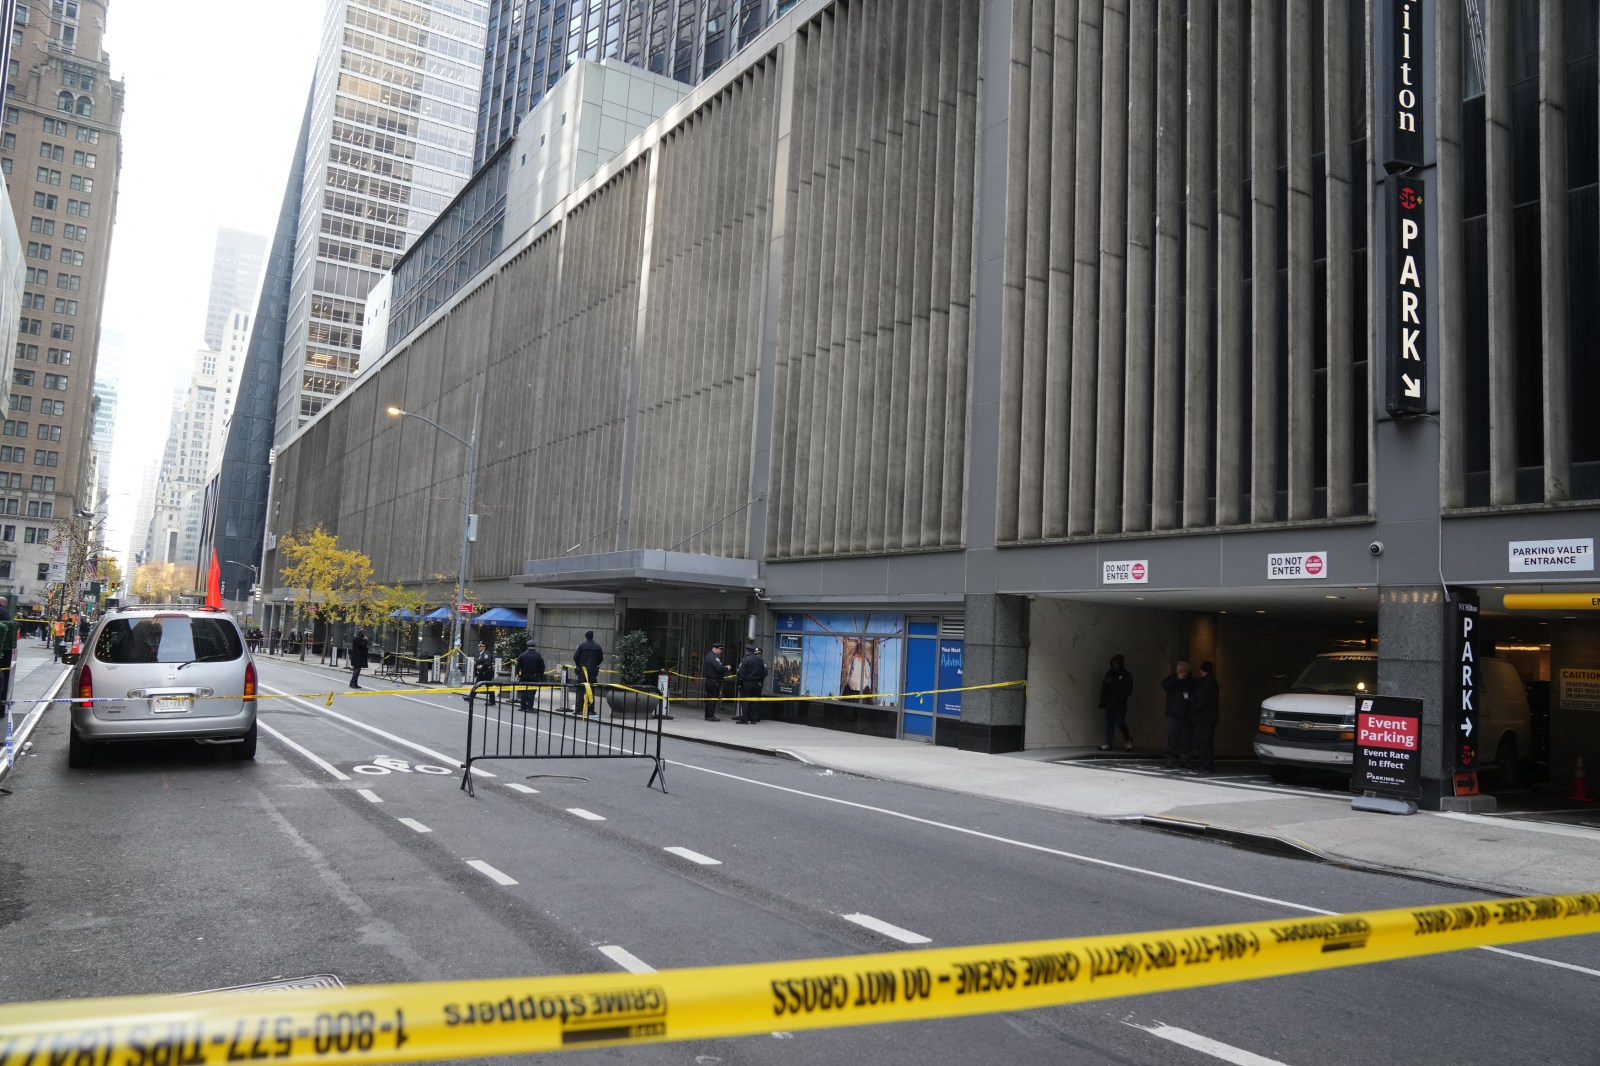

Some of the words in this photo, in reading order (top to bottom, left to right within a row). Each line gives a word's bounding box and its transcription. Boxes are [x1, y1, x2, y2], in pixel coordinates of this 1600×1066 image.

[1398, 0, 1416, 133] ilton
[1399, 218, 1421, 362] PARK
[1512, 546, 1555, 556] PARKING
[1557, 545, 1589, 554] VALET
[1105, 564, 1115, 572] DO
[1116, 564, 1130, 572] NOT
[1271, 557, 1283, 566] DO
[1284, 556, 1303, 566] NOT
[1524, 556, 1577, 566] ENTRANCE
[1106, 572, 1129, 580] ENTER
[1272, 566, 1301, 575] ENTER
[941, 653, 963, 669] Advent
[1461, 616, 1474, 711] PARK
[1367, 716, 1408, 731] Event
[1360, 729, 1414, 748] Parking
[1363, 748, 1388, 758] Event
[1389, 751, 1410, 760] Rate
[1368, 759, 1377, 767] In
[1378, 760, 1405, 770] Effect
[1019, 951, 1081, 988] CRIME
[901, 967, 933, 1002] DO
[953, 959, 1018, 997] SCENE
[770, 974, 849, 1017] CROSS
[853, 971, 896, 1008] NOT
